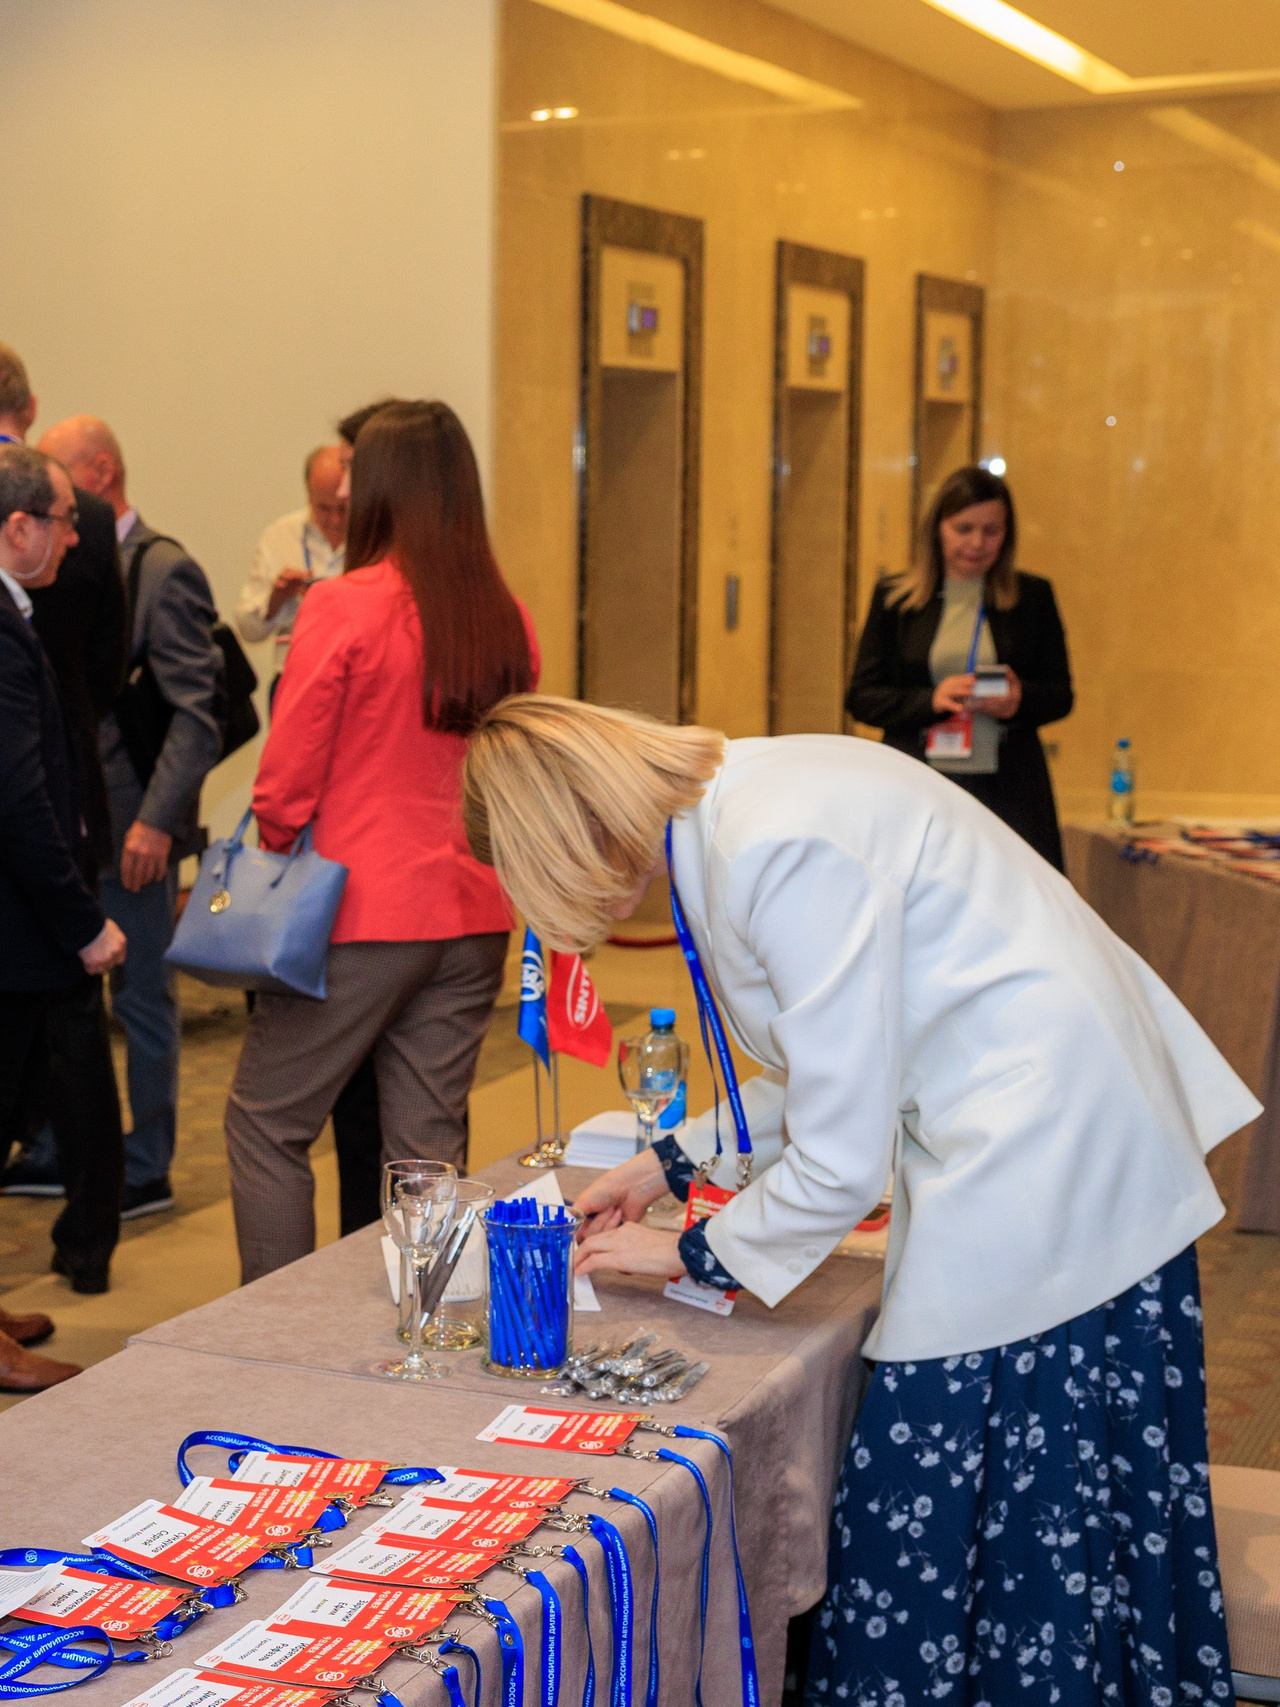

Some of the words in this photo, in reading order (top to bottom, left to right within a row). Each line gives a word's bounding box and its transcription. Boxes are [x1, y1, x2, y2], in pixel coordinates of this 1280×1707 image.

[140, 1529, 169, 1546] Сергей
[149, 1531, 186, 1553] Сундуков
[49, 1589, 78, 1606] Андрей
[548, 1597, 556, 1634] ДИЛЕРЫ»
[33, 1630, 84, 1658] АССОЦИАЦИЯ
[547, 1635, 555, 1706] АВТОМОБИЛЬНЫЕ
